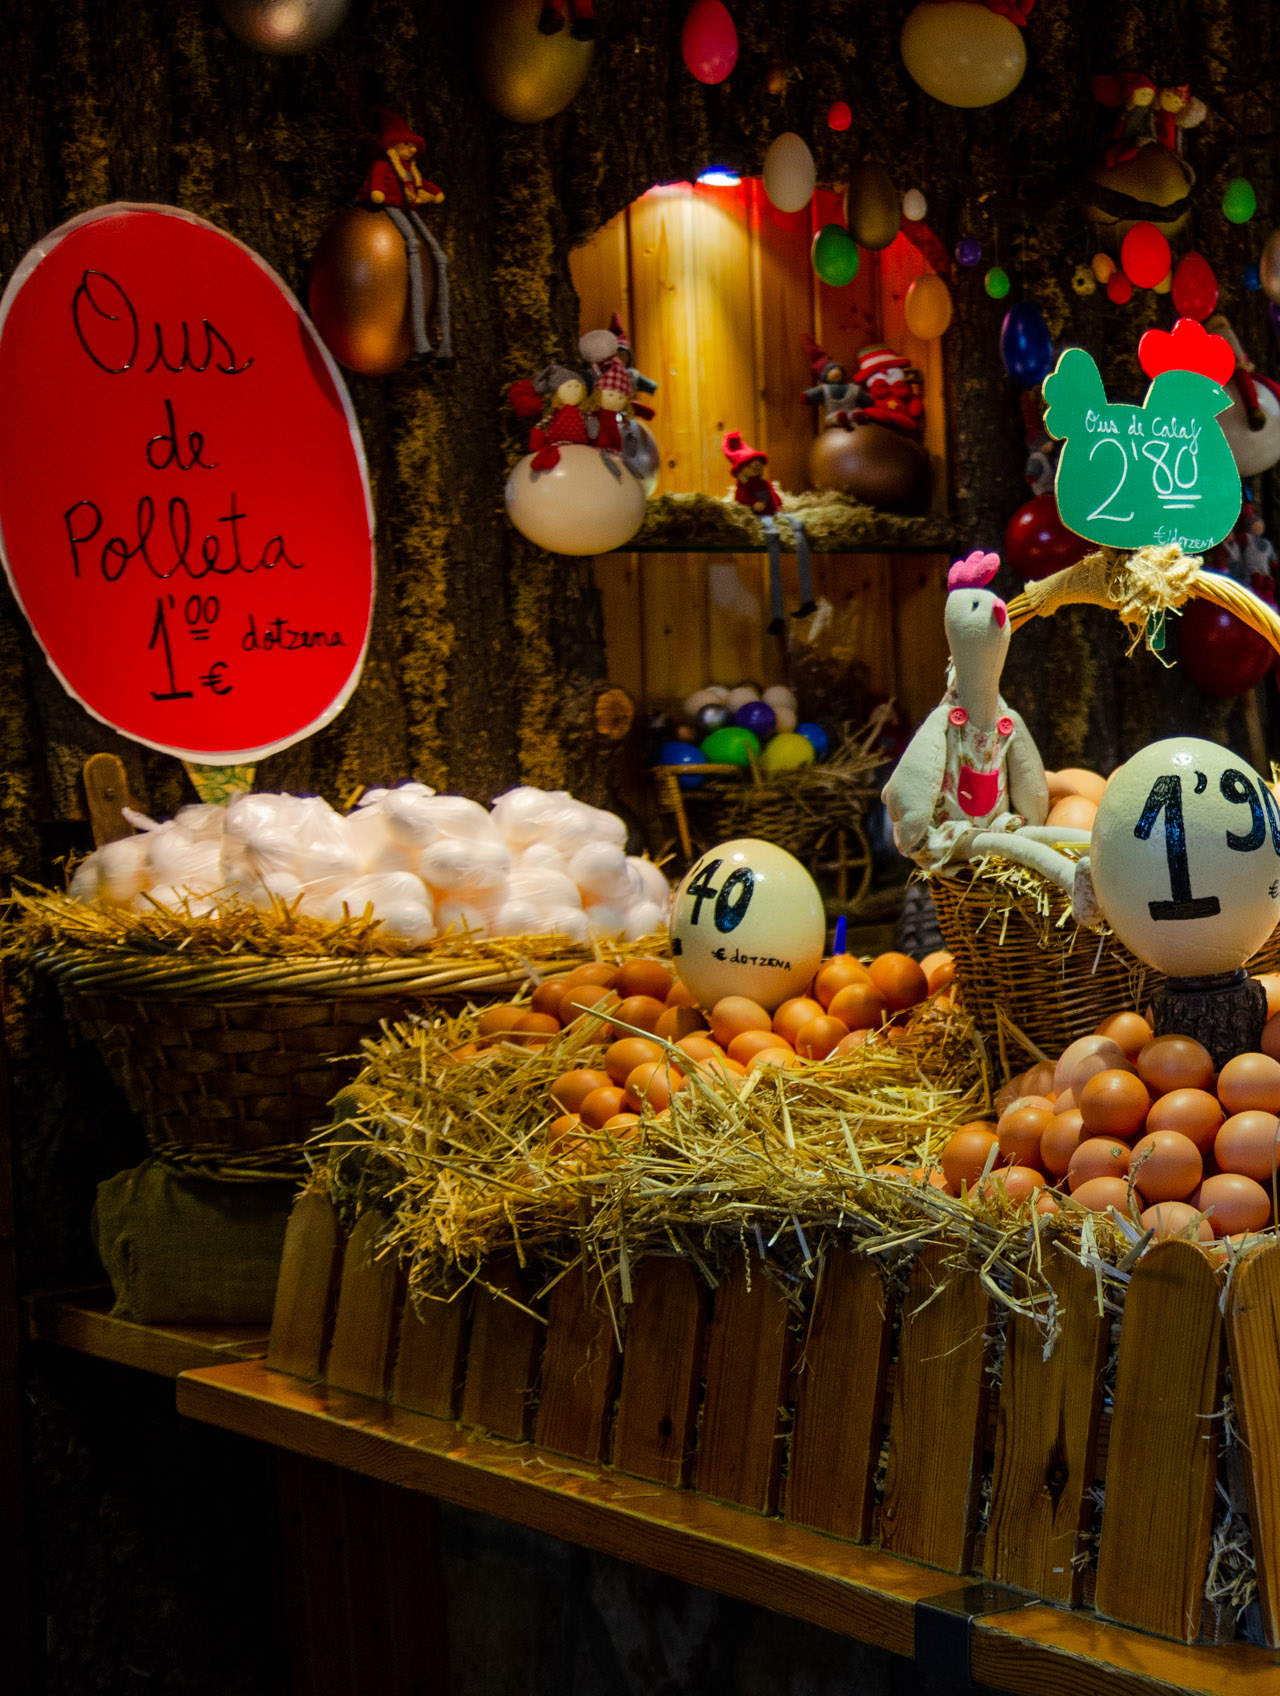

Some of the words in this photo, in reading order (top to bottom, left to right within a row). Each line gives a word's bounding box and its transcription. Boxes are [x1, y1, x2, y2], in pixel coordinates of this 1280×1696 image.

[72, 270, 254, 374] Ous
[146, 399, 218, 470] de
[1085, 409, 1120, 433] Ous
[1128, 414, 1144, 437] de
[1152, 417, 1202, 455] Calaf
[1086, 438, 1200, 522] 2'80
[64, 493, 304, 581] Polleta
[199, 661, 233, 695] €
[712, 948, 727, 961] €
